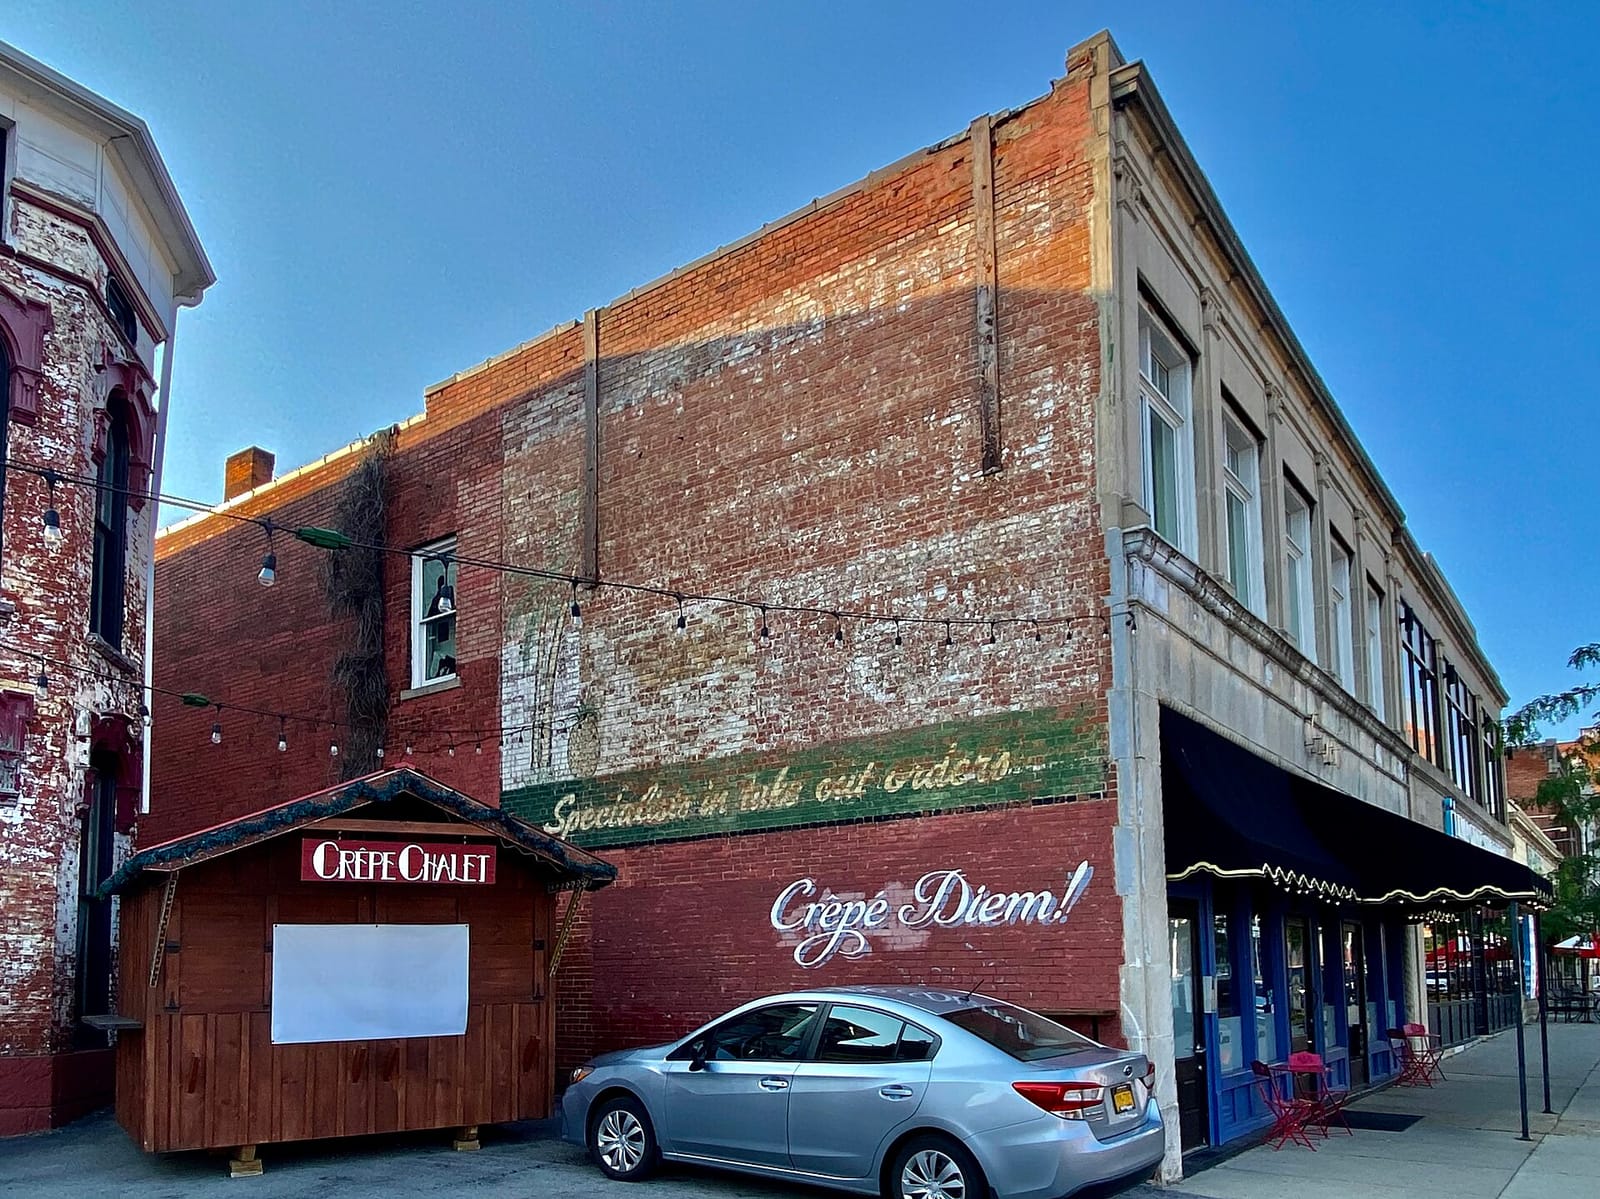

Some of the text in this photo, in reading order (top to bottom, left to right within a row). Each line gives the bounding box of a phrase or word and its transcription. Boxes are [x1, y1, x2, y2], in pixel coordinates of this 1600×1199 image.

[699, 780, 729, 817] in
[740, 766, 803, 811] take
[815, 761, 874, 802] out
[884, 742, 1011, 792] orders
[398, 844, 490, 882] CHALET
[770, 860, 1092, 968] Crêpé Diem!
